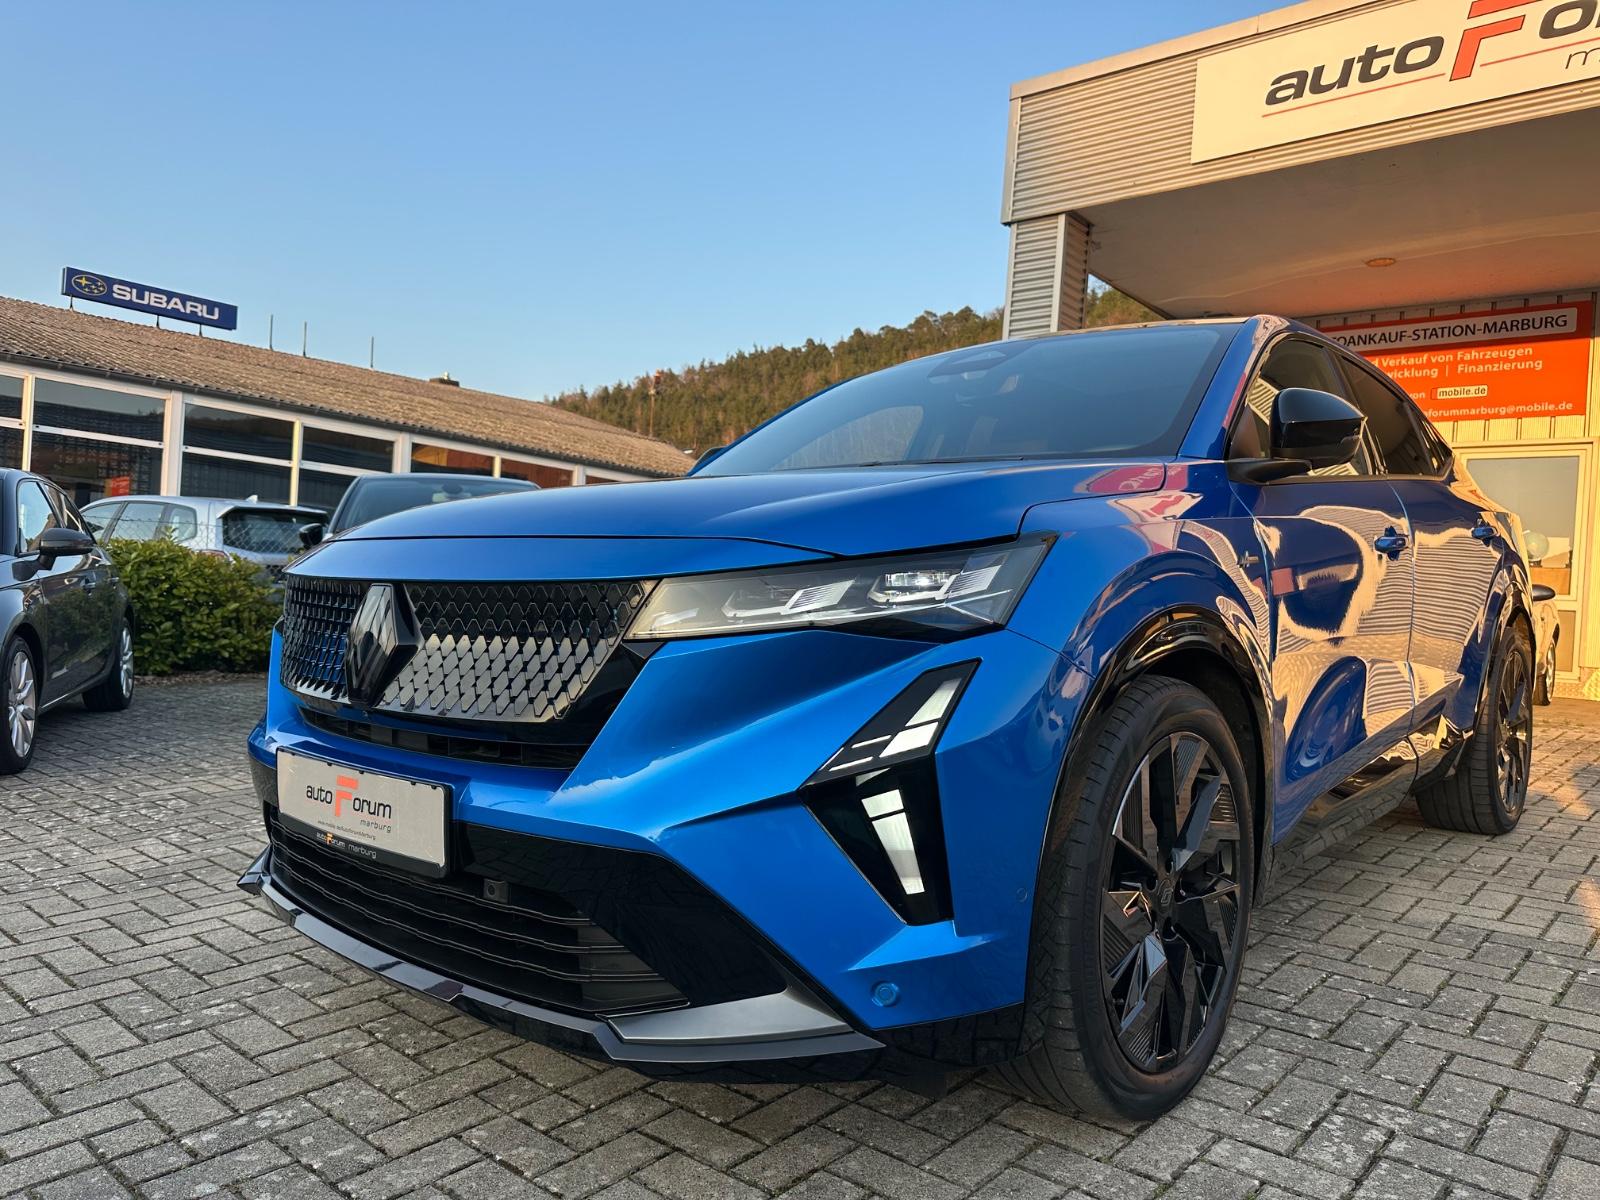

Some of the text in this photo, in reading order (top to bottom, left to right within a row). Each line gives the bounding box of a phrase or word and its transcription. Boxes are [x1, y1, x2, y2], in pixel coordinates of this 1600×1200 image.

[1264, 0, 1600, 106] autoFo
[112, 284, 220, 320] SUBARU
[1333, 314, 1568, 347] OANKAUF-STATION-MARBURG
[1382, 353, 1428, 368] Verkauf
[1430, 353, 1453, 363] von
[1457, 345, 1533, 362] Fahrzeugen
[1457, 358, 1543, 374] Finanzierung
[1438, 386, 1487, 398] mobile.de
[360, 819, 392, 834] marburg
[348, 843, 377, 859] marburg
